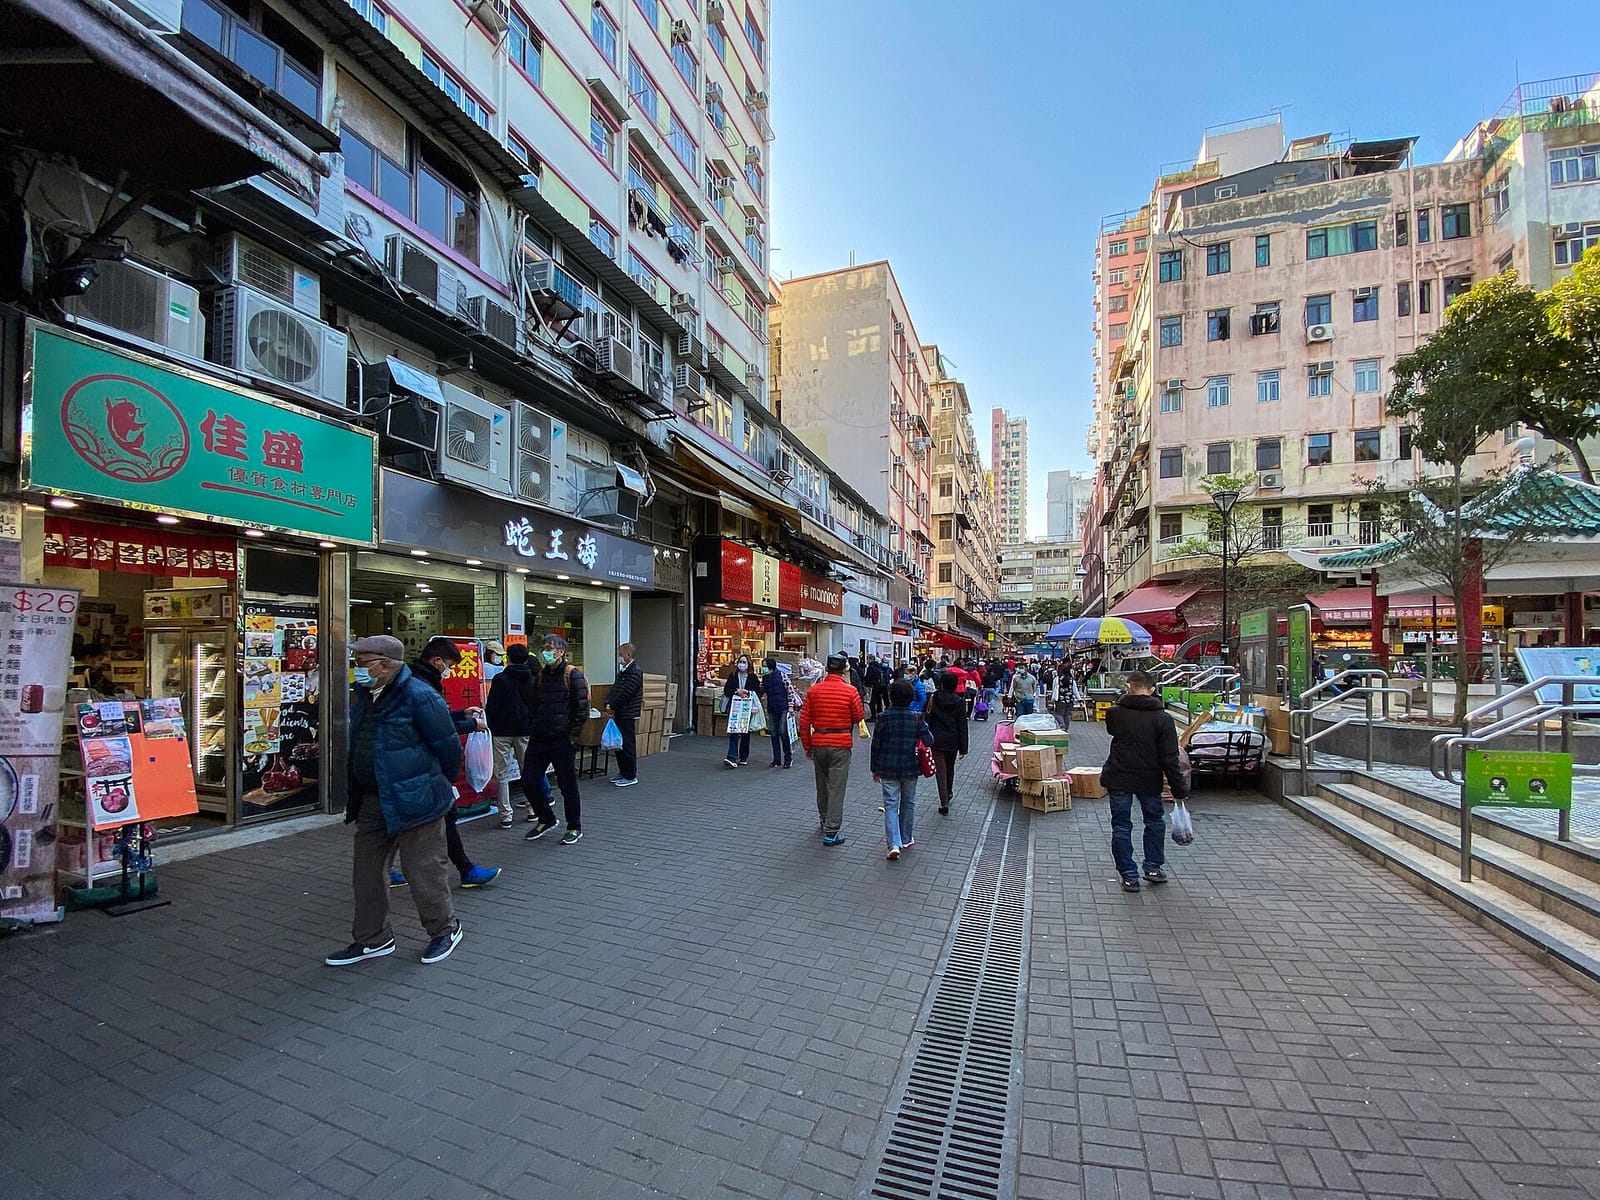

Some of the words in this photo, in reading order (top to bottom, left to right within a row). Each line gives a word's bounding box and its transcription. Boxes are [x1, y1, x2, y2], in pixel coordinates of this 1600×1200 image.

[200, 409, 303, 473] 佳盛
[227, 466, 358, 508] 優質食材專門店
[12, 589, 76, 613] $26
[810, 586, 840, 608] mannings
